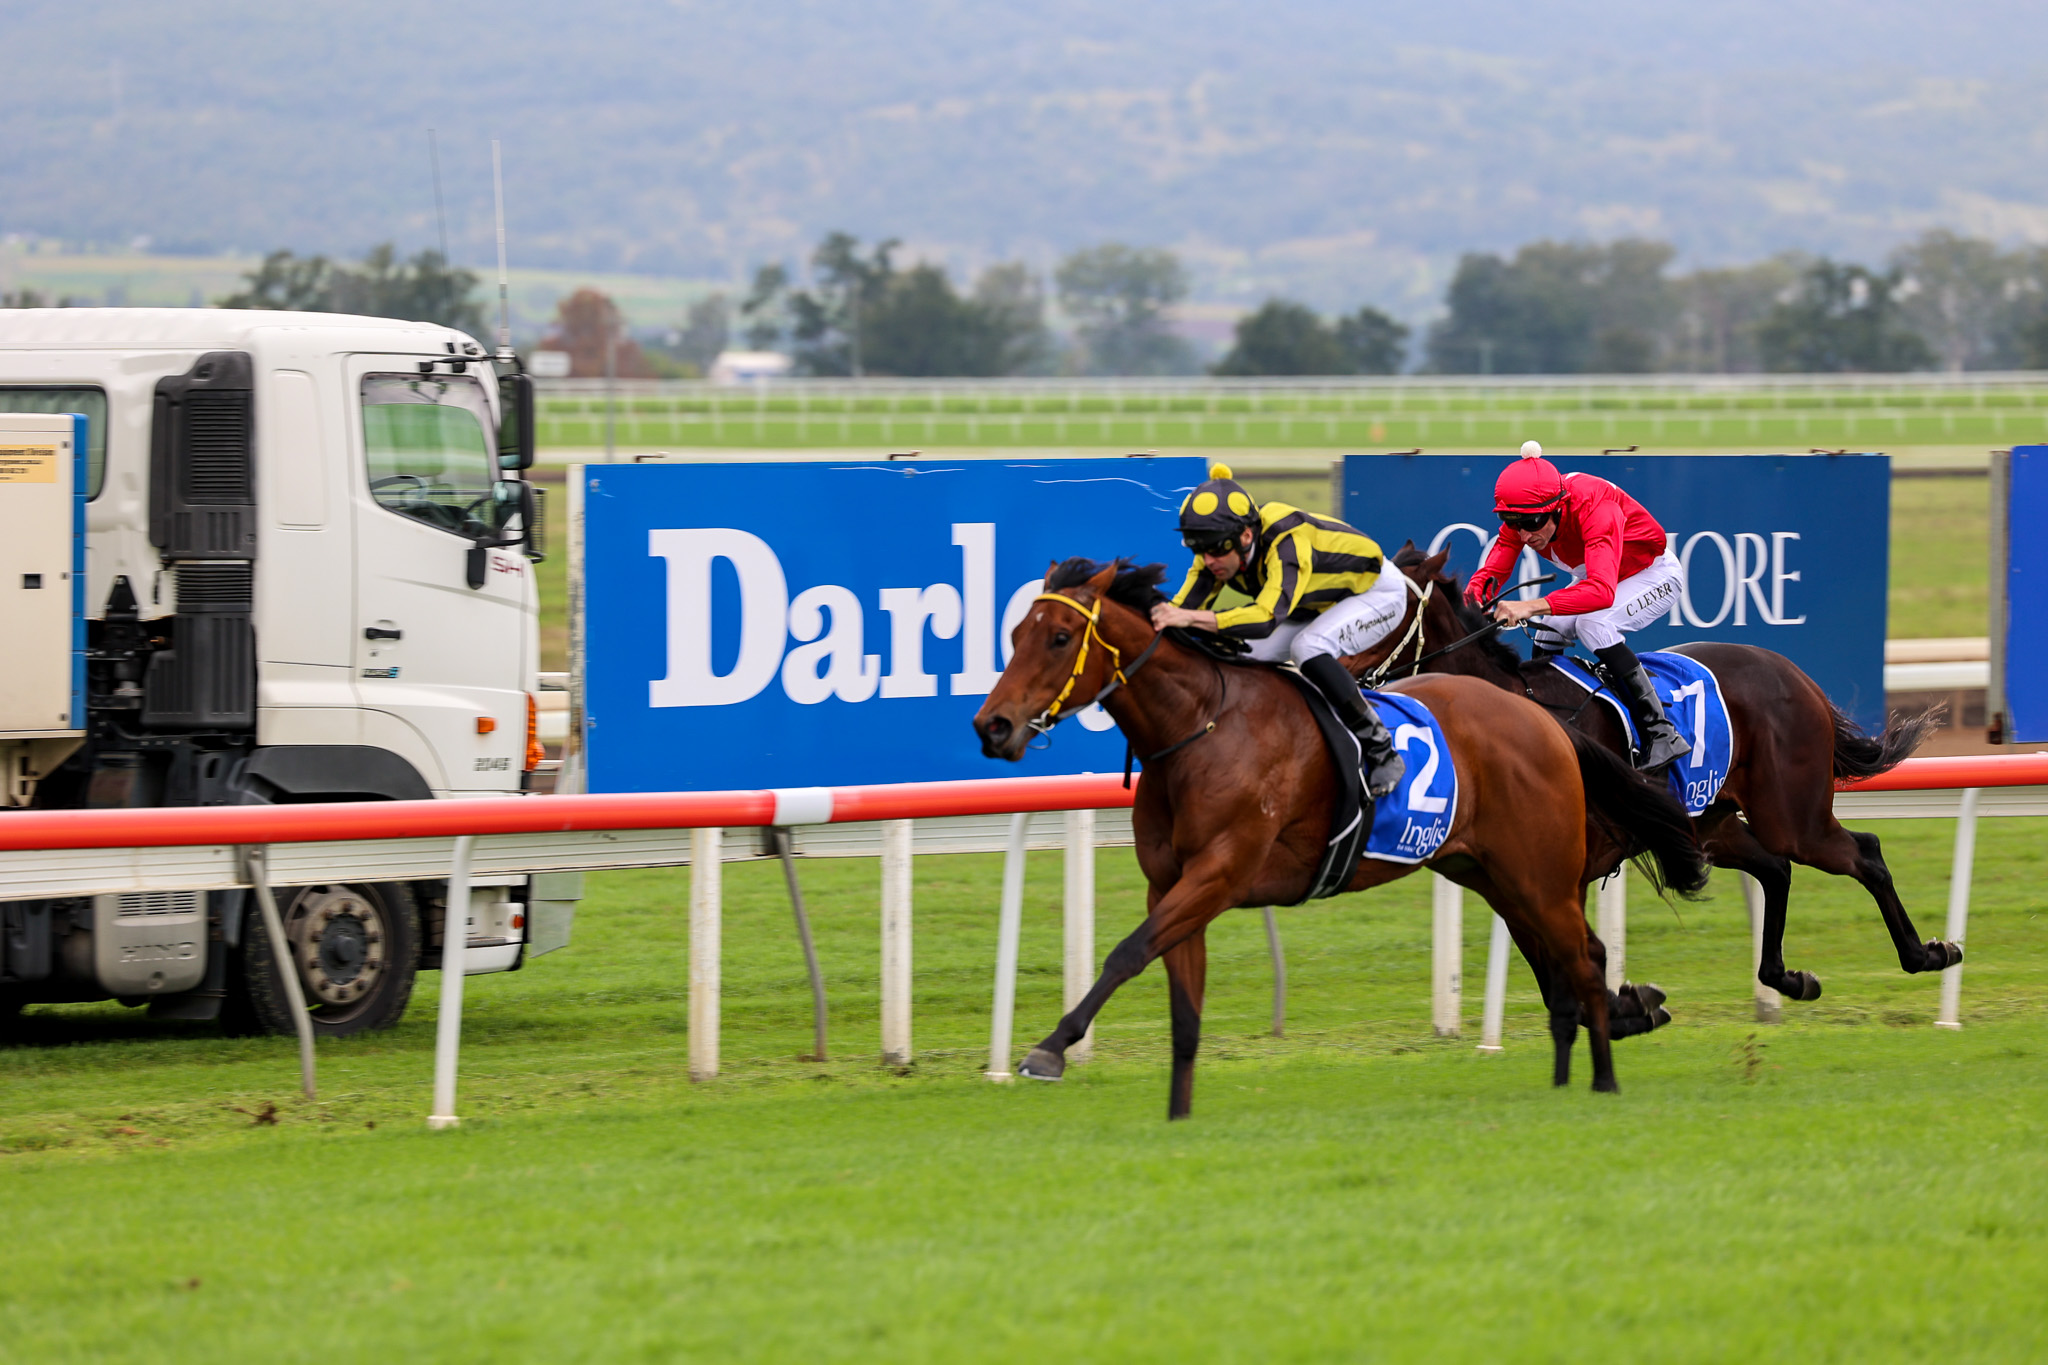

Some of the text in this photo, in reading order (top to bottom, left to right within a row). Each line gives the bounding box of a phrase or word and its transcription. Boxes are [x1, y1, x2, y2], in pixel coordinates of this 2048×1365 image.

[649, 522, 1117, 731] Darl
[1637, 582, 1672, 610] LEVER
[1669, 680, 1706, 768] 7
[1395, 723, 1448, 813] 2
[1400, 816, 1447, 857] Inglis
[119, 941, 196, 963] HINO
